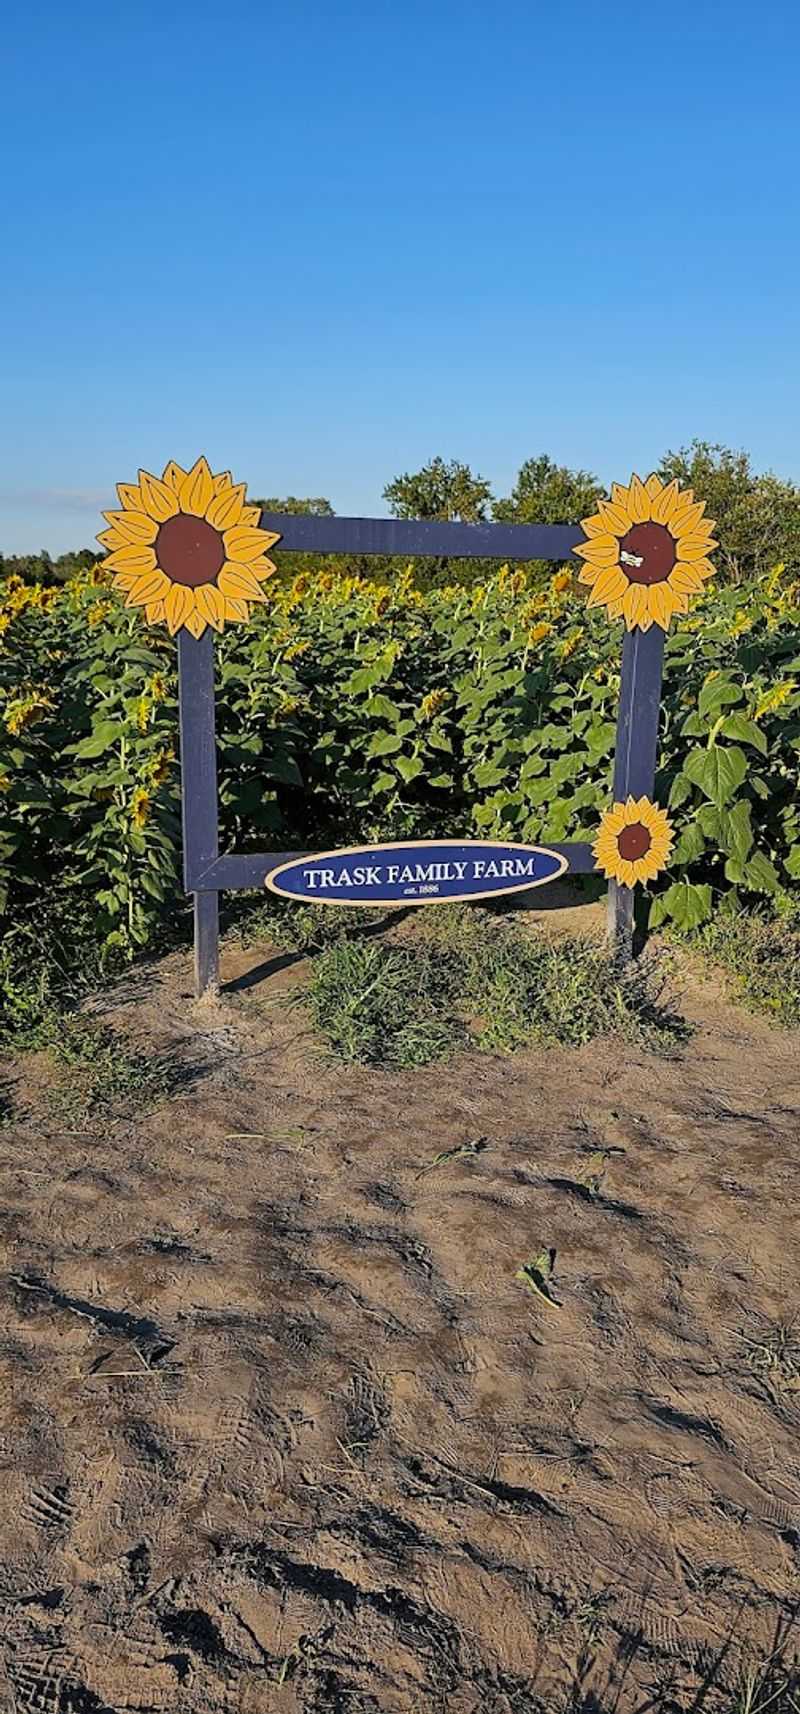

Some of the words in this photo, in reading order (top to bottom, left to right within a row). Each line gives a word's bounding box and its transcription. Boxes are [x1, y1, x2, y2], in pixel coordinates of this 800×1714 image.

[304, 867, 382, 888] TRASK
[387, 862, 468, 883] FAMILY
[472, 858, 535, 879] FARM
